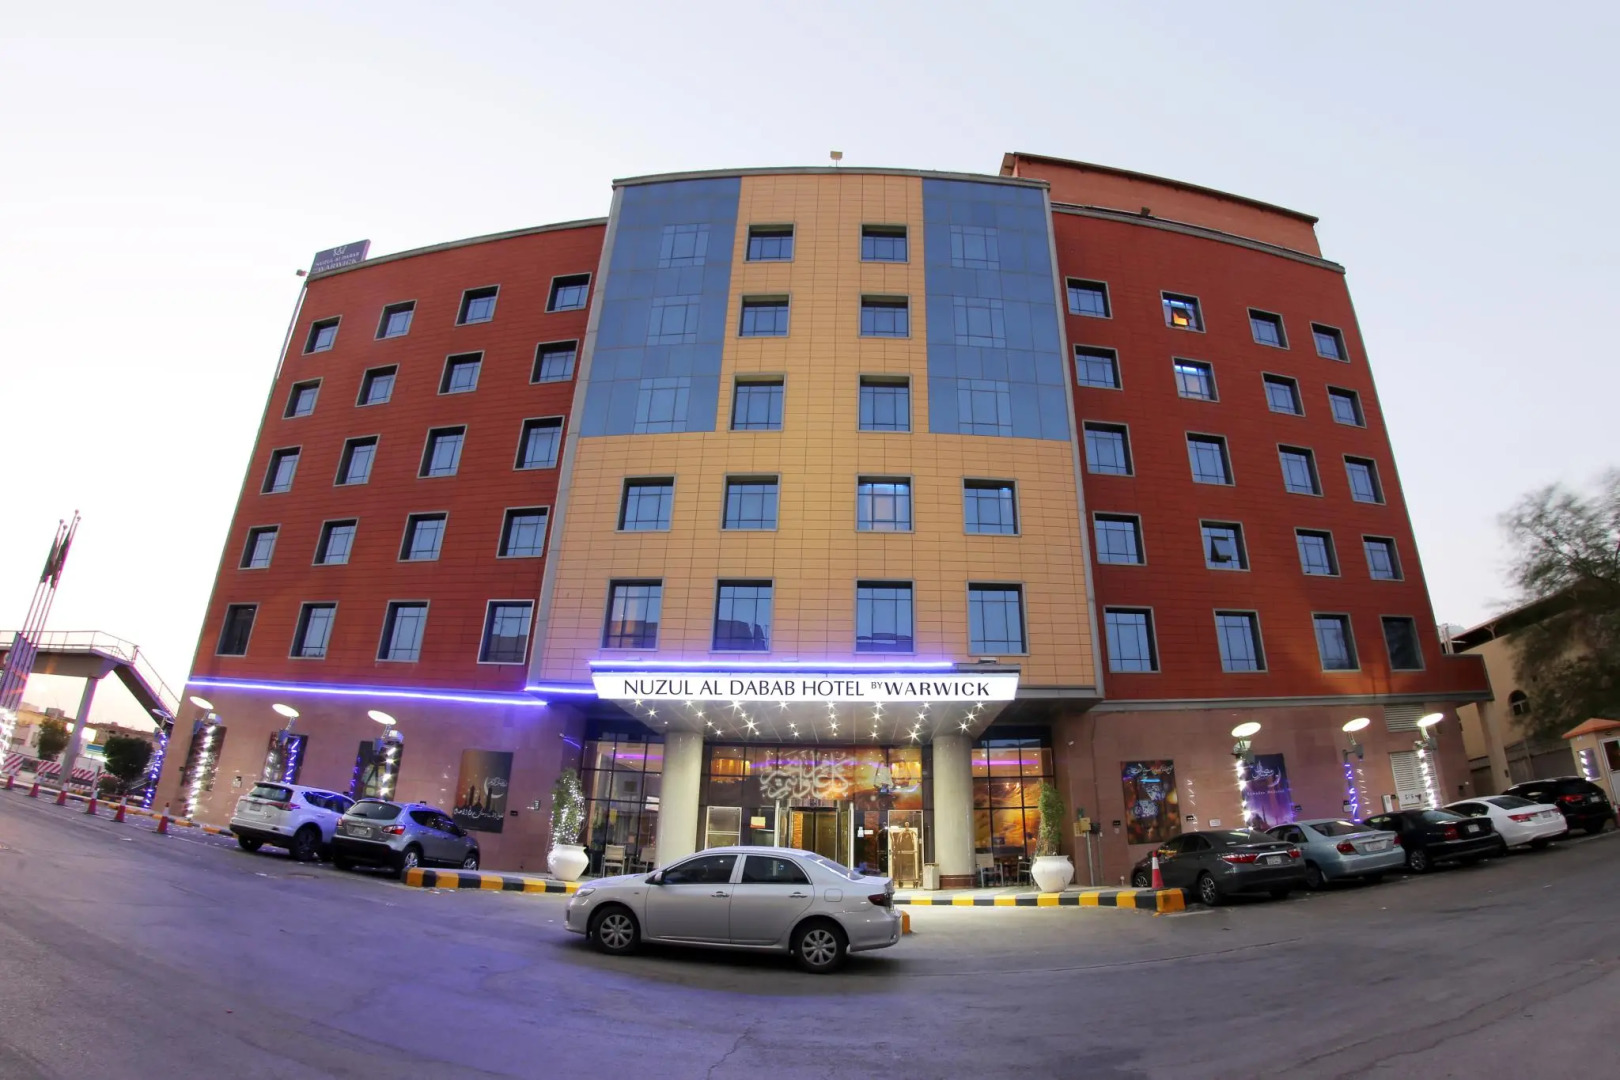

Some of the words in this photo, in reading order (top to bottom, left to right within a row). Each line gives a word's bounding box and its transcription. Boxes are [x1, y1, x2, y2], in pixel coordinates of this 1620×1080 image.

[624, 679, 694, 695] NUZUL
[699, 680, 723, 696] AL
[729, 680, 796, 696] DABAB
[802, 680, 865, 697] HOTEL
[870, 681, 884, 690] BY
[884, 681, 990, 697] WARWICK
